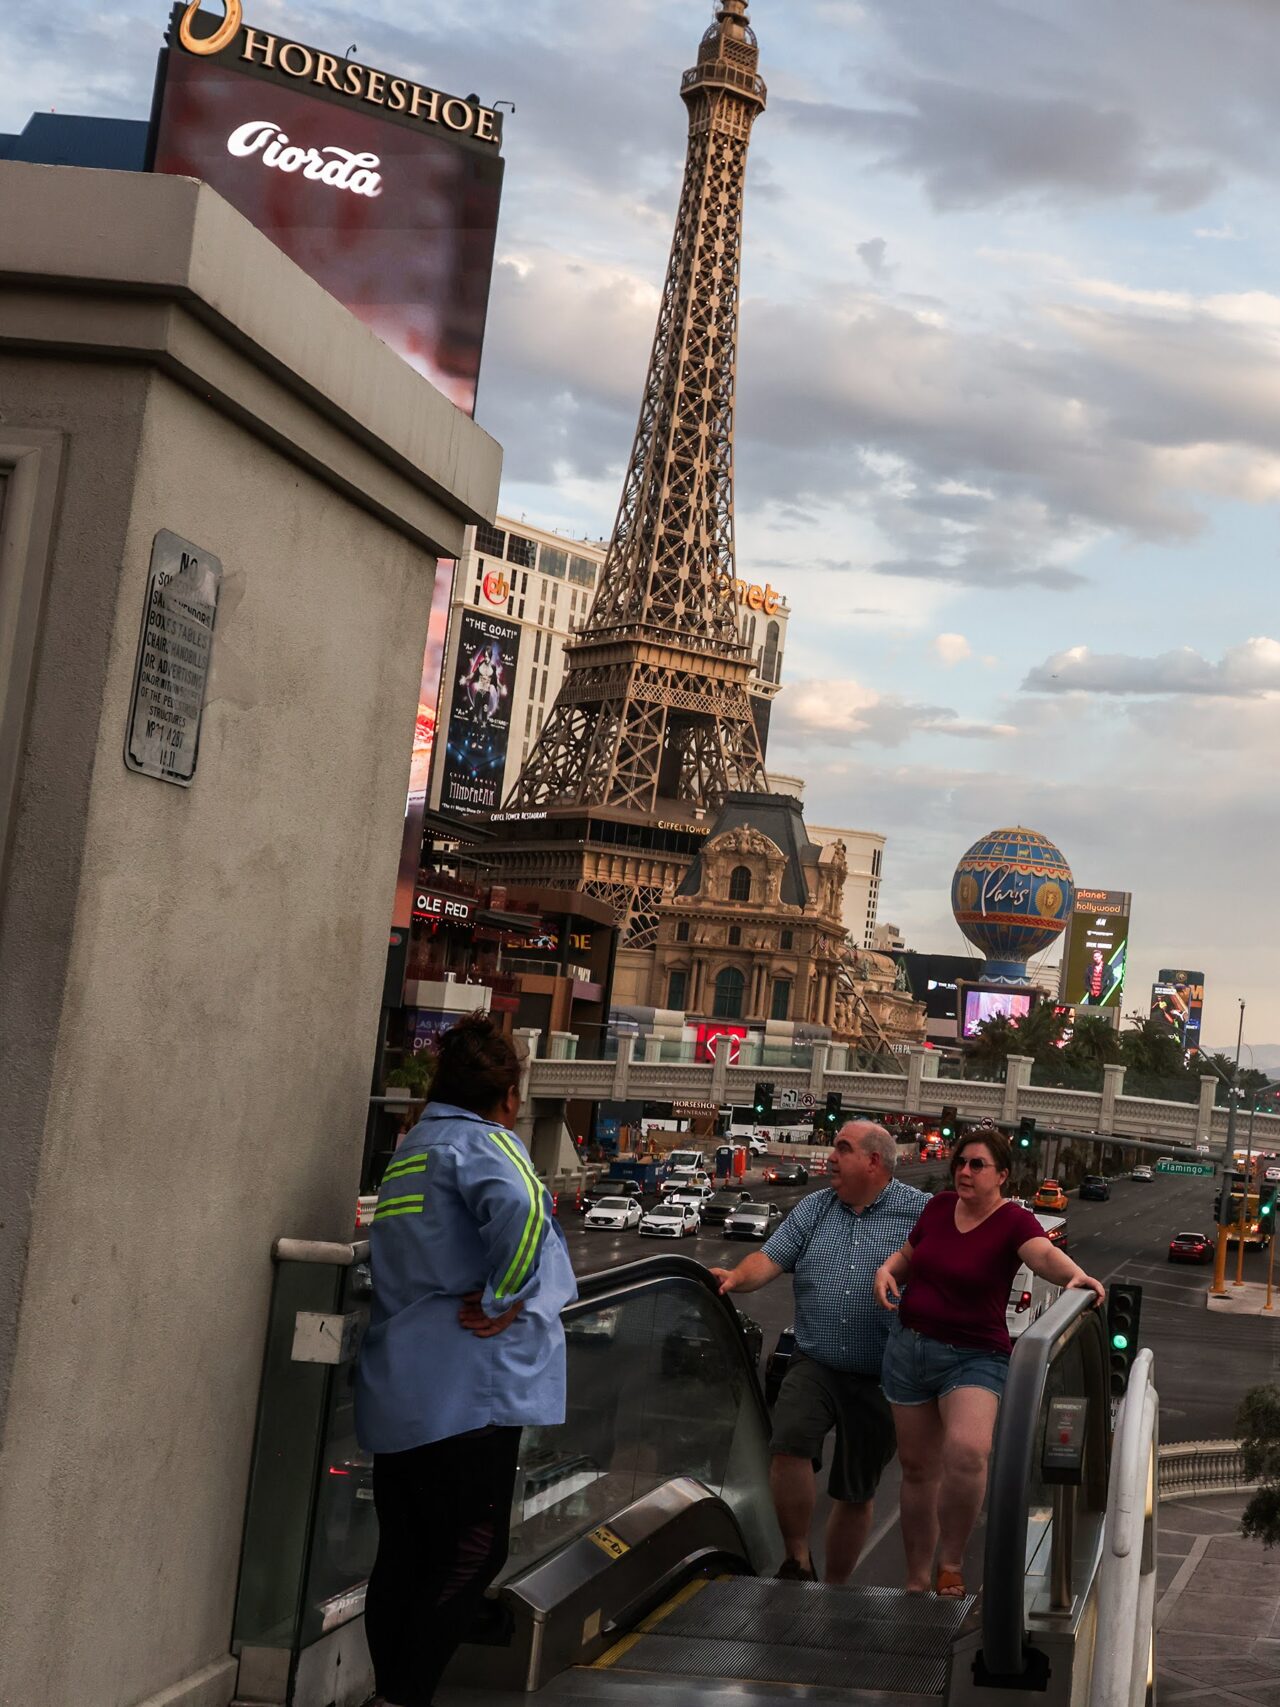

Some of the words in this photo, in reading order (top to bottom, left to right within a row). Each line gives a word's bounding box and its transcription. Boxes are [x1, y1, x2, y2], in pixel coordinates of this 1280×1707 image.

[179, 622, 208, 650] TABLES
[144, 653, 155, 669] OR
[658, 820, 684, 832] EIFFEL
[981, 863, 1029, 917] Paris
[1077, 890, 1107, 900] planet
[417, 895, 442, 913] OLE
[444, 901, 469, 918] RED
[1076, 901, 1121, 913] hollywood
[1161, 1162, 1203, 1175] Flamingo
